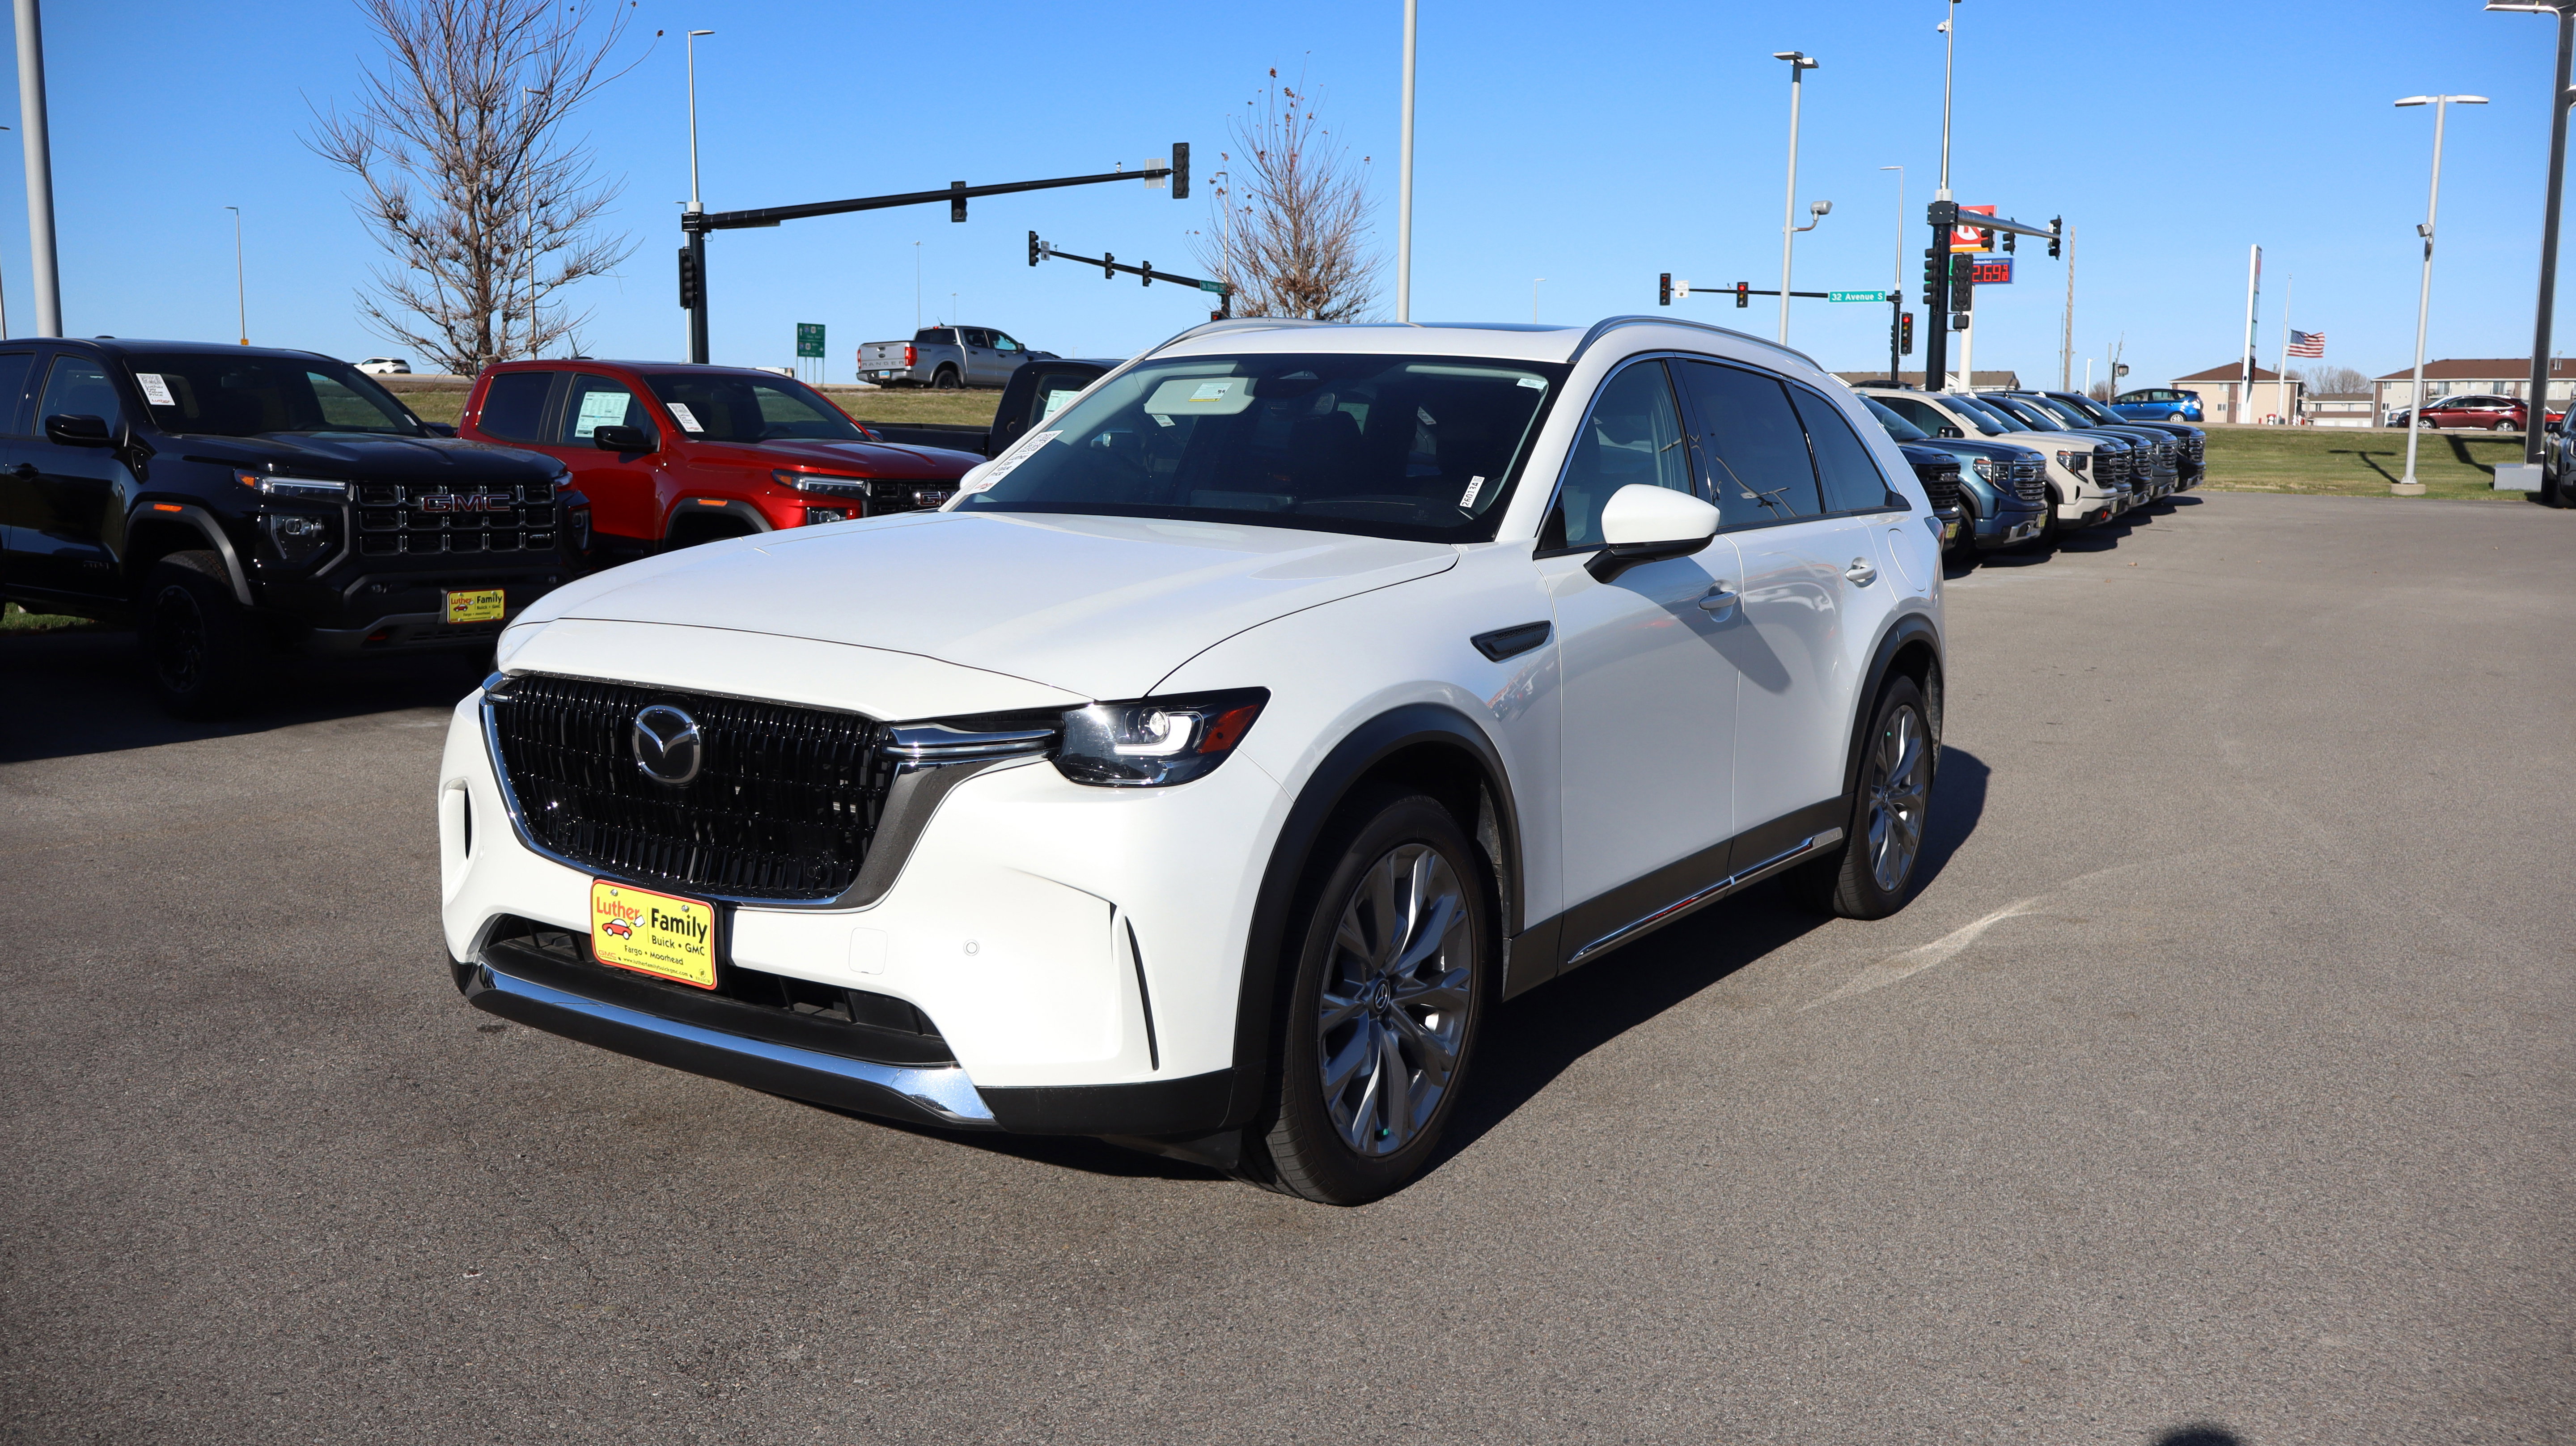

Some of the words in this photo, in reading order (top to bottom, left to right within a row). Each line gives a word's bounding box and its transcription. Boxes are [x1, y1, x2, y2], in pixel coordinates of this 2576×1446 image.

[421, 494, 510, 512] GMC
[477, 594, 502, 603] Family
[597, 897, 640, 920] Luther
[651, 907, 708, 944] Family
[598, 950, 617, 958] GMC
[652, 935, 675, 949] Buick
[685, 943, 705, 956] GMC
[624, 945, 643, 956] Fargo
[650, 951, 683, 966] Moorhead
